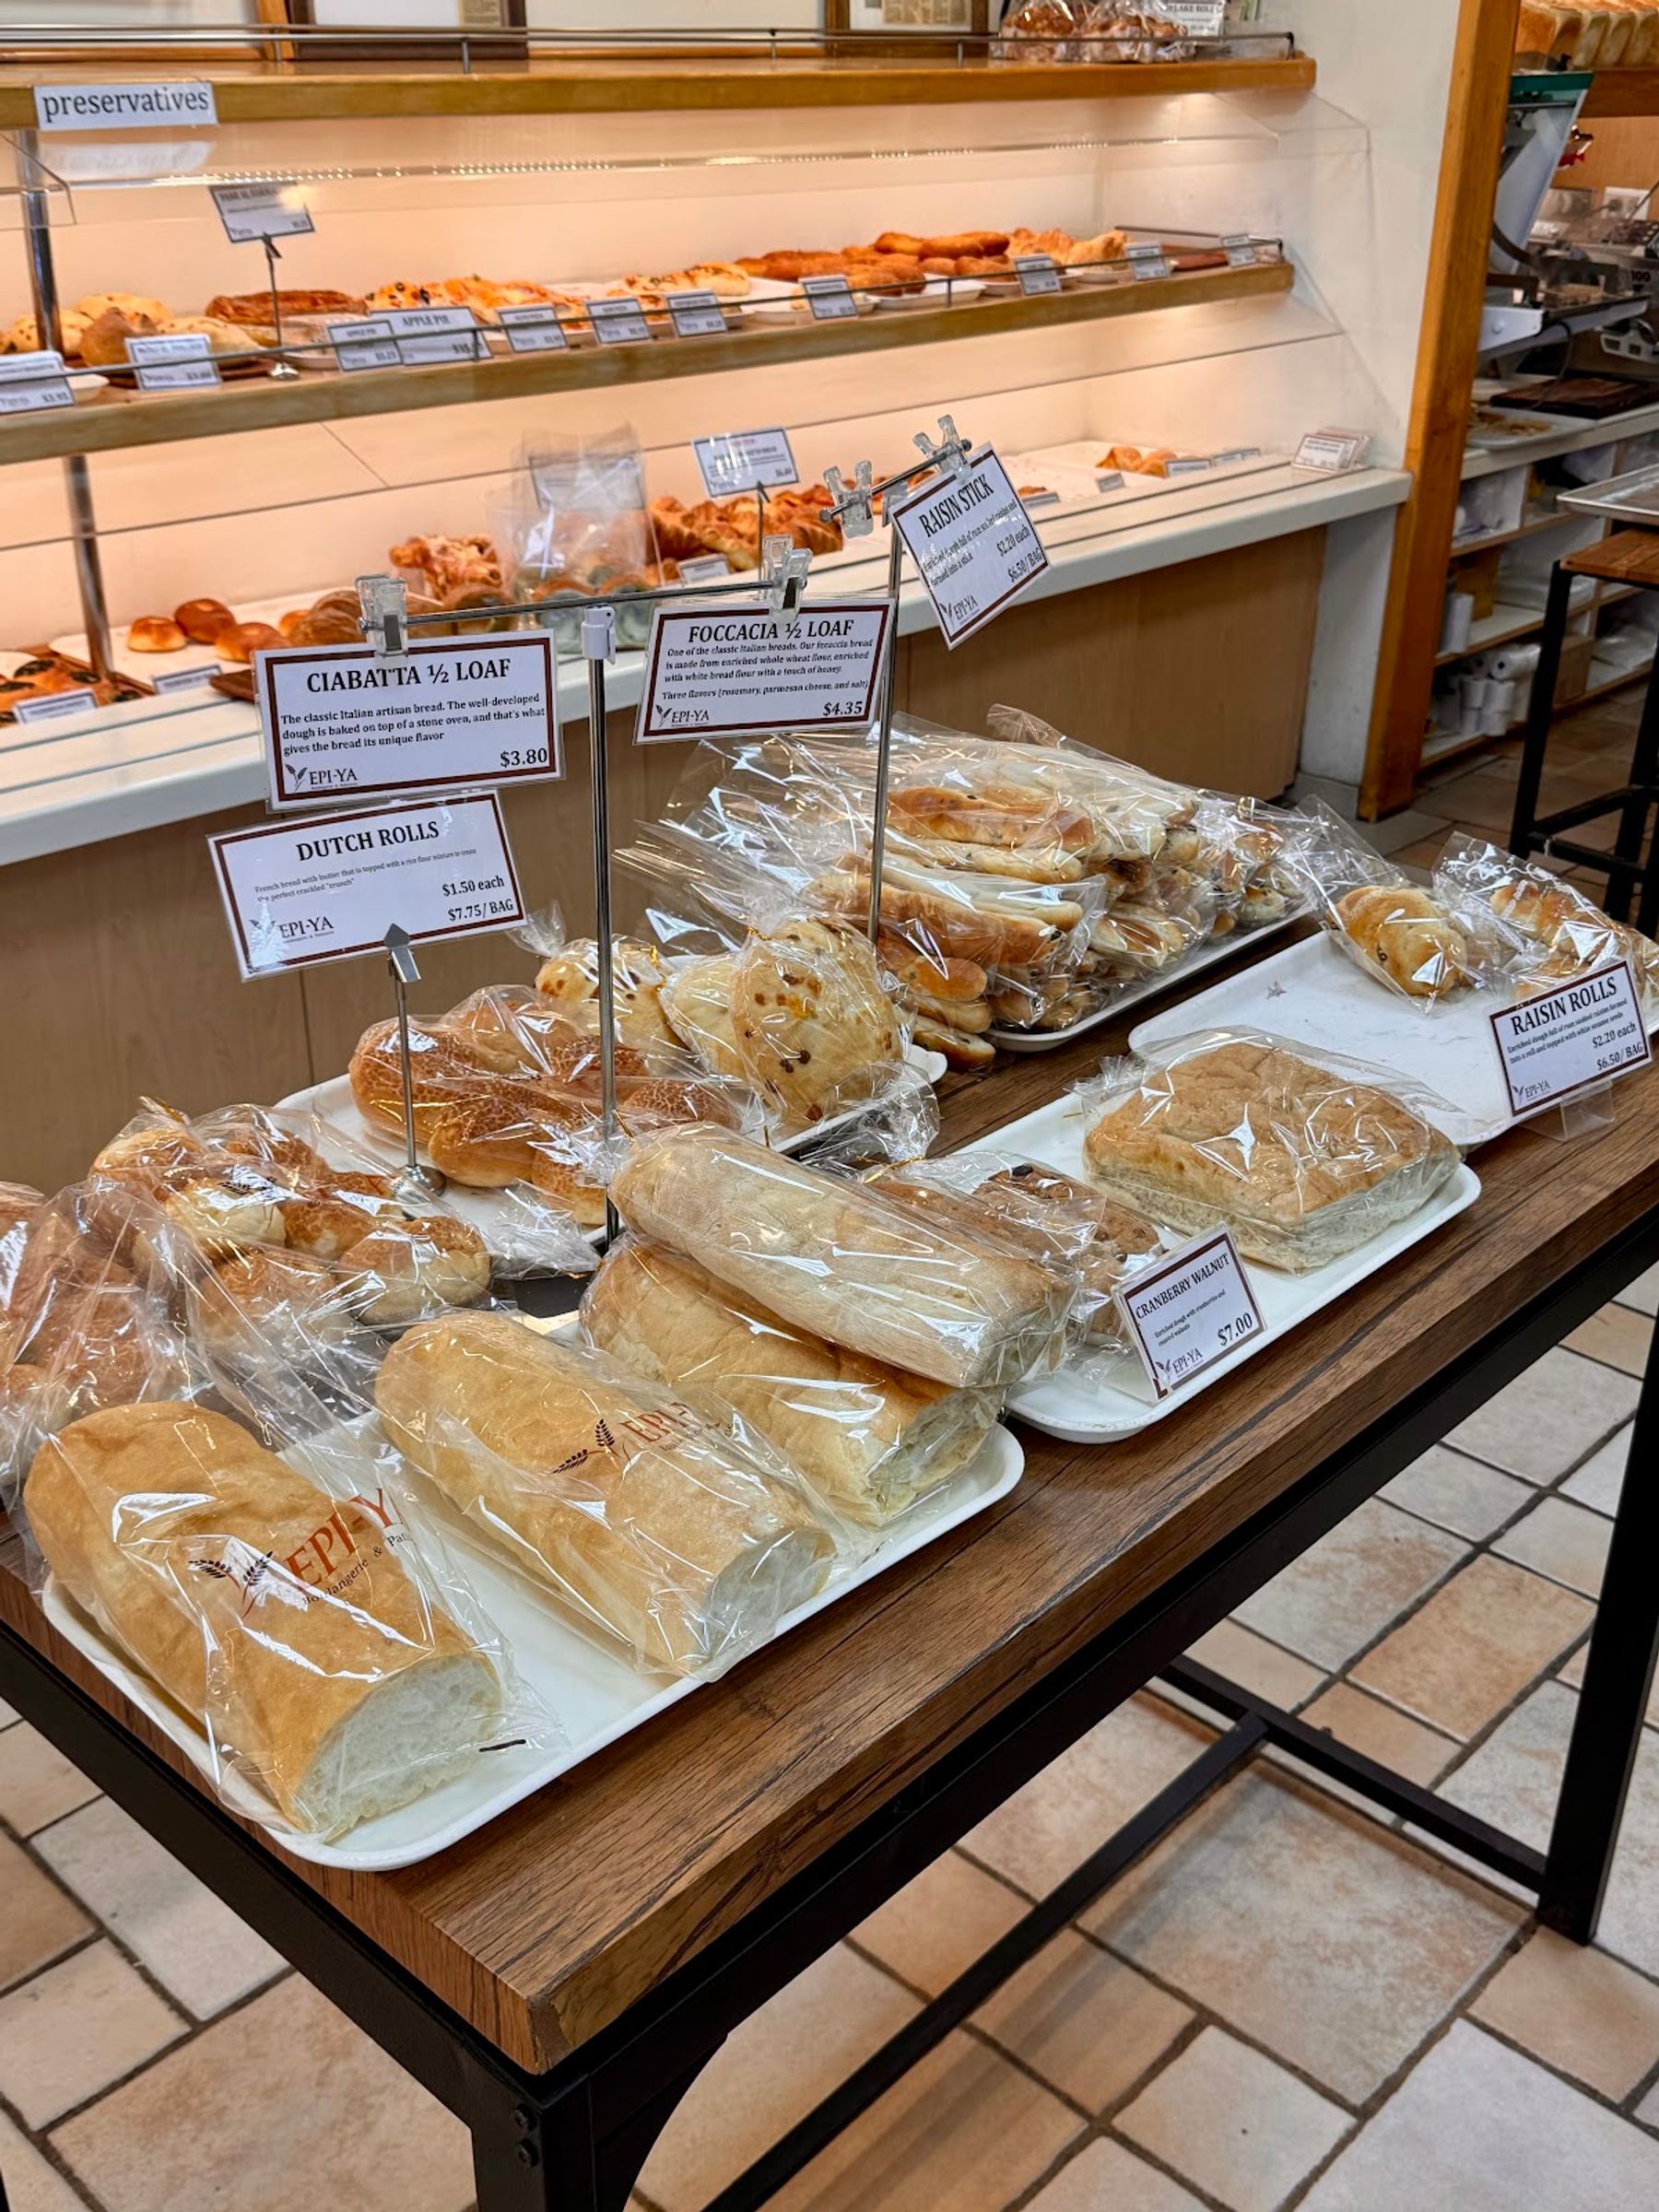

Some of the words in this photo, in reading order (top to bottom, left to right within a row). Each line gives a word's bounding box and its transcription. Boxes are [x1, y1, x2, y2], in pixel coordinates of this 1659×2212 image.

[42, 88, 208, 124] preservatives
[919, 495, 963, 537] RAISIN
[958, 474, 994, 512] STICK
[996, 534, 1016, 557] $2.20
[1015, 524, 1030, 544] each
[1027, 547, 1041, 567] BAG
[953, 595, 978, 620] EPI-YA
[688, 624, 779, 642] FOCCACIA
[785, 622, 801, 639] ½
[807, 619, 854, 638] LOAF
[667, 648, 684, 657] One
[686, 646, 695, 655] of
[696, 645, 710, 655] the
[712, 644, 738, 654] classic
[740, 643, 767, 653] Italian
[800, 641, 815, 650] Our
[849, 639, 874, 648] bread
[675, 659, 698, 669] made
[700, 658, 720, 667] from
[722, 656, 758, 666] enriched
[759, 654, 783, 665] whole
[785, 653, 810, 664] wheat
[833, 652, 869, 661] enriched
[307, 666, 421, 693] CIABATTA
[428, 664, 450, 685] ½
[456, 658, 512, 681] LOAF
[665, 674, 683, 682] with
[685, 672, 708, 681] white
[710, 670, 734, 679] bread
[735, 669, 756, 678] flour
[758, 667, 775, 677] with
[783, 666, 805, 676] touch
[807, 665, 816, 675] of
[663, 690, 687, 700] Three
[688, 688, 716, 699] flavors
[763, 685, 803, 696] parmesan
[834, 680, 849, 689] and
[282, 713, 301, 725] The
[304, 710, 338, 724] classic
[340, 708, 374, 720] Italian
[376, 704, 412, 717] artisan
[413, 700, 445, 715] bread.
[447, 700, 466, 711] The
[468, 692, 540, 710] well-developed
[672, 710, 710, 723] EPI-YA
[822, 700, 863, 716] $4.35
[282, 726, 315, 740] dough
[318, 726, 326, 737] is
[328, 723, 360, 735] baked
[363, 723, 376, 733] on
[378, 721, 394, 735] top
[397, 719, 409, 729] of
[409, 721, 415, 729] a
[417, 716, 443, 728] stone
[445, 715, 472, 726] oven,
[473, 712, 491, 723] and
[522, 707, 545, 718] what
[284, 745, 310, 758] gives
[312, 742, 329, 752] the
[332, 737, 361, 750] bread
[363, 736, 376, 747] its
[379, 733, 414, 747] unique
[417, 731, 444, 743] flavor
[500, 747, 547, 769] $3.80
[310, 769, 358, 785] EPI-YA
[296, 831, 373, 861] DUTCH
[378, 821, 439, 846] ROLLS
[254, 883, 280, 893] French
[280, 878, 301, 888] bread
[318, 872, 339, 880] butter
[362, 863, 385, 873] topped
[442, 880, 476, 897] $1.50
[478, 876, 504, 890] each
[271, 890, 296, 901] perfect
[296, 884, 325, 895] crackled
[448, 902, 486, 922] $7.75/
[489, 899, 513, 913] BAG
[279, 916, 334, 938] EPI-YA
[1511, 997, 1566, 1035] RAISIN
[1568, 976, 1617, 1012] ROLLS
[1507, 1039, 1532, 1053] Enriched
[1532, 1032, 1548, 1043] dough
[1548, 1028, 1558, 1036] full
[1558, 1024, 1564, 1033] of
[1525, 1048, 1535, 1057] roll
[1536, 1043, 1547, 1053] and
[1547, 1036, 1565, 1049] topped
[1565, 1031, 1577, 1041] with
[1577, 1027, 1591, 1035] white
[1609, 1012, 1623, 1021] seeds
[1593, 1030, 1616, 1049] $2.20
[1618, 1022, 1637, 1038] each
[1597, 1049, 1624, 1071] $6.50/
[1626, 1042, 1642, 1057] BAG
[1524, 1080, 1550, 1098] EPI-YA
[1136, 1278, 1191, 1319] CRANBERRY
[1191, 1253, 1229, 1284] WALNUT
[1218, 1289, 1226, 1298] and
[1218, 1312, 1253, 1346] $7.00
[1172, 1347, 1203, 1373] EPI-YA
[284, 1488, 404, 1588] EPI-Y
[373, 1547, 382, 1558] &
